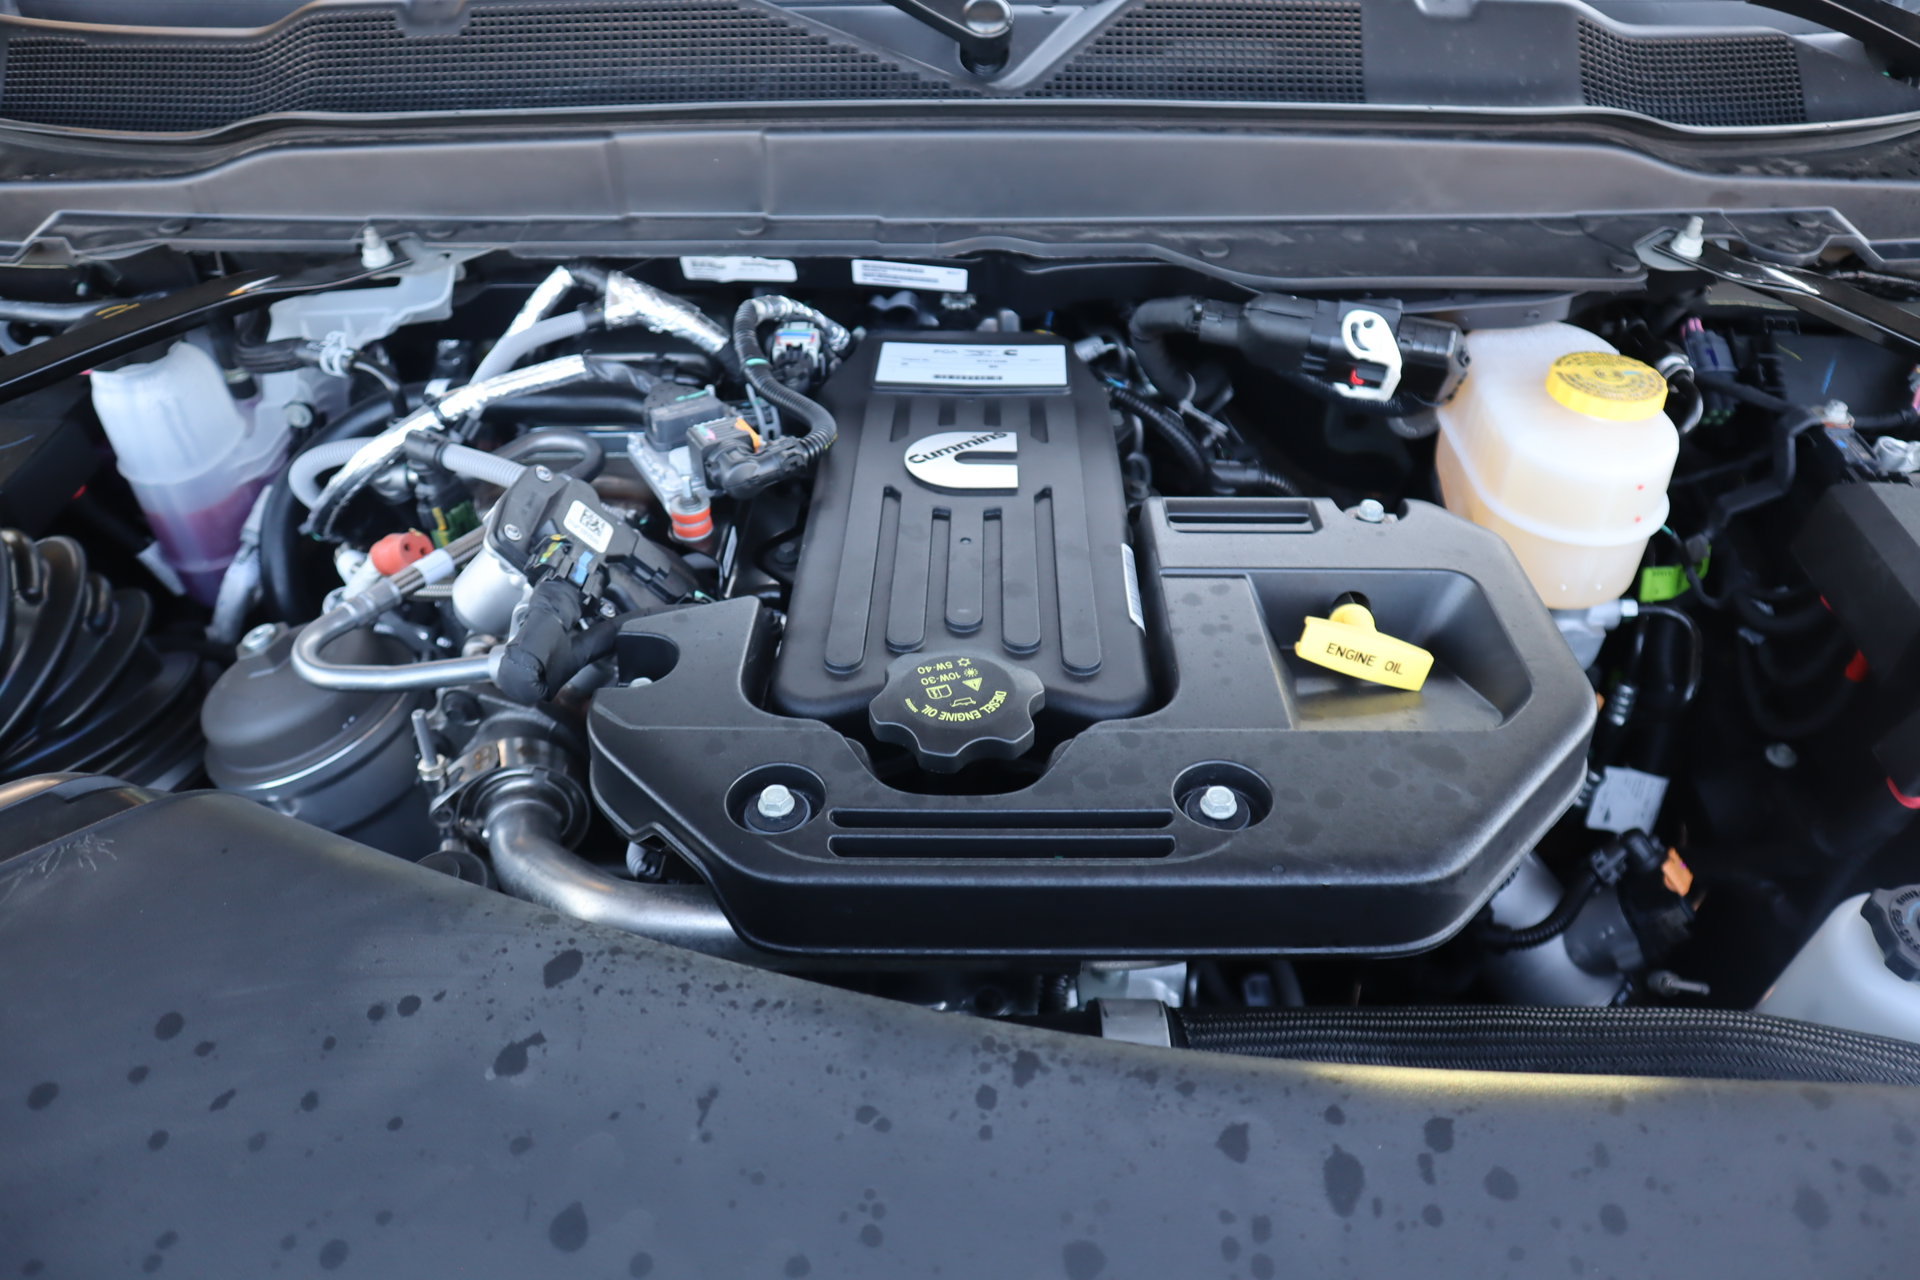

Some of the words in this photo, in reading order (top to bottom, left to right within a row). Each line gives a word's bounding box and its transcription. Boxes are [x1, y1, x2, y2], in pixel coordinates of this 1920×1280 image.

[908, 431, 1008, 464] Cummins
[1326, 642, 1377, 667] ENGINE
[1384, 660, 1404, 675] OIL
[917, 661, 953, 675] 5W-40
[920, 672, 961, 685] 10W-30
[979, 690, 1008, 714] DIESEL
[921, 704, 938, 718] OIL
[938, 709, 982, 722] ENGINE
